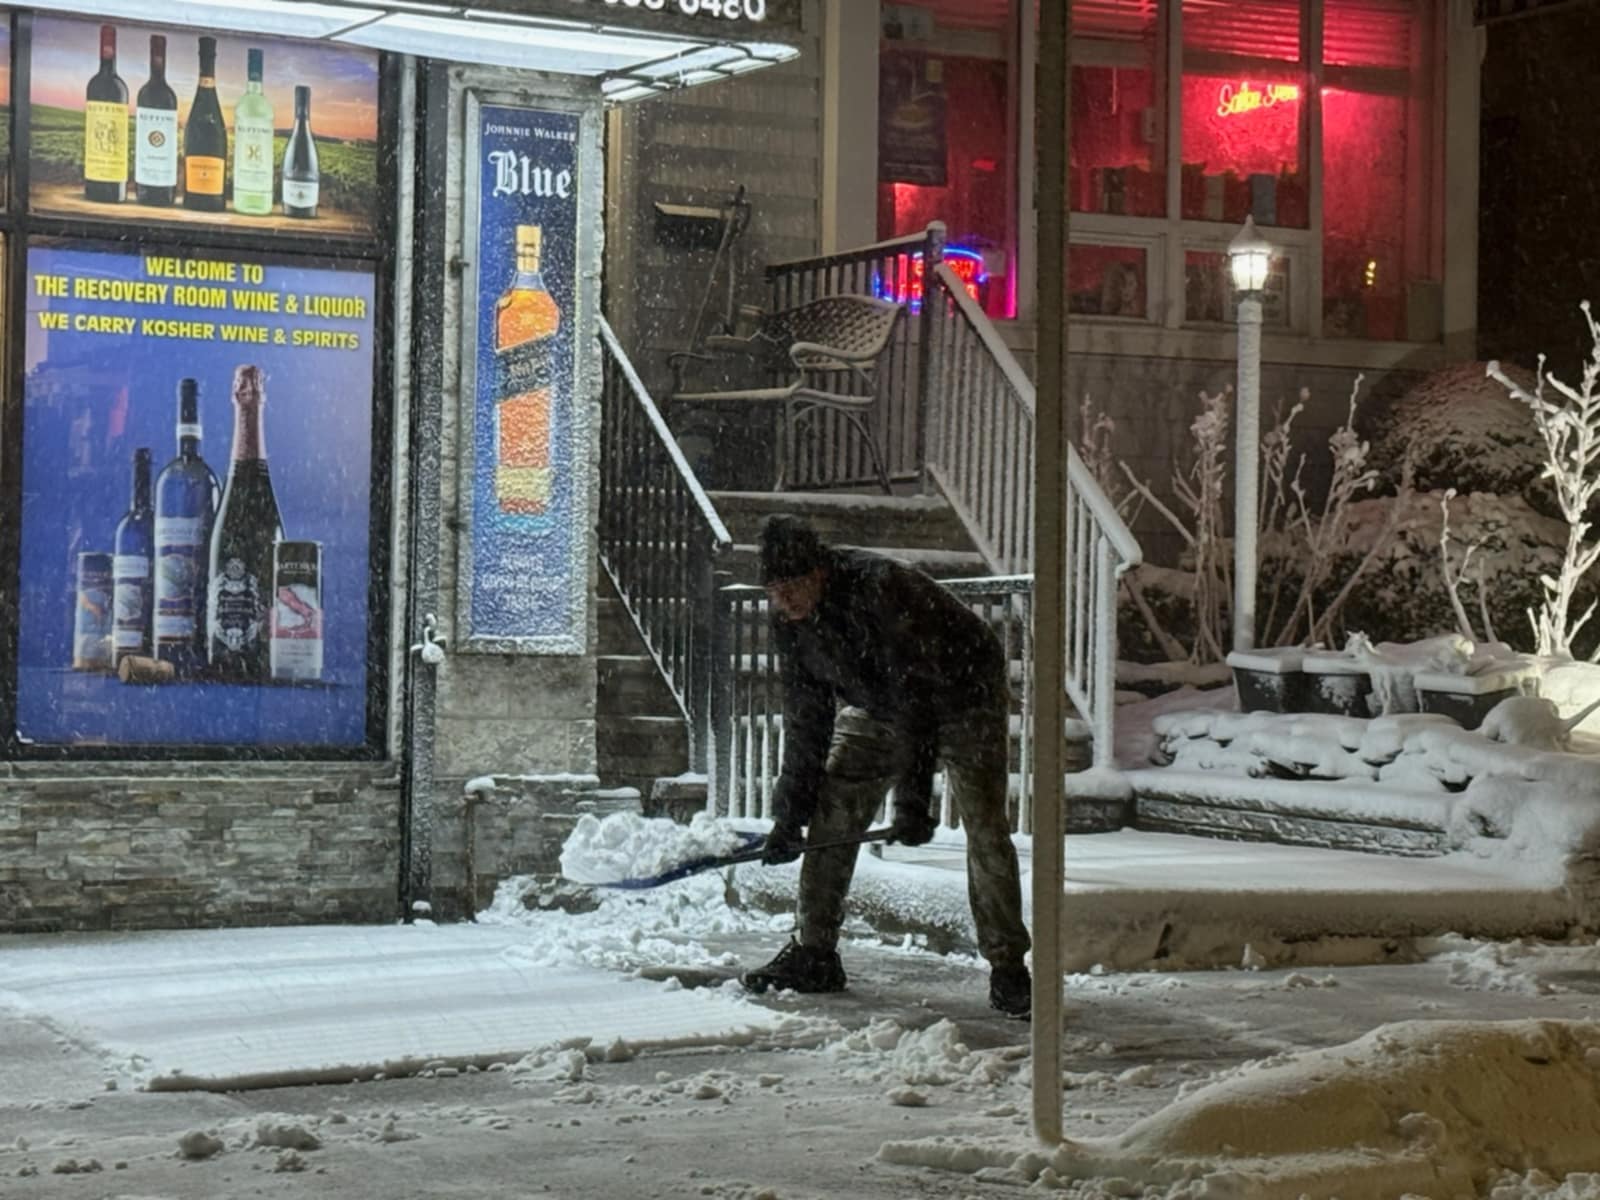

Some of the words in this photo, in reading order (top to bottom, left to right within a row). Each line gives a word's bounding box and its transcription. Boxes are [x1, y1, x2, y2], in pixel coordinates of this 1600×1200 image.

[484, 122, 531, 137] JOHNNIE
[487, 149, 572, 199] Blue
[146, 256, 237, 283] WELCOME
[241, 263, 264, 284] TO
[34, 275, 69, 298] THE
[74, 279, 169, 305] RECOVERY
[173, 286, 226, 309] ROOM
[232, 290, 280, 313] WINE
[285, 294, 299, 314] &
[304, 295, 366, 319] LIQUOR
[38, 311, 69, 330] WE
[75, 315, 136, 335] CARRY
[142, 319, 215, 341] KOSHER
[220, 324, 269, 344] WINE
[273, 328, 287, 345] &
[292, 330, 359, 350] SPIRITS
